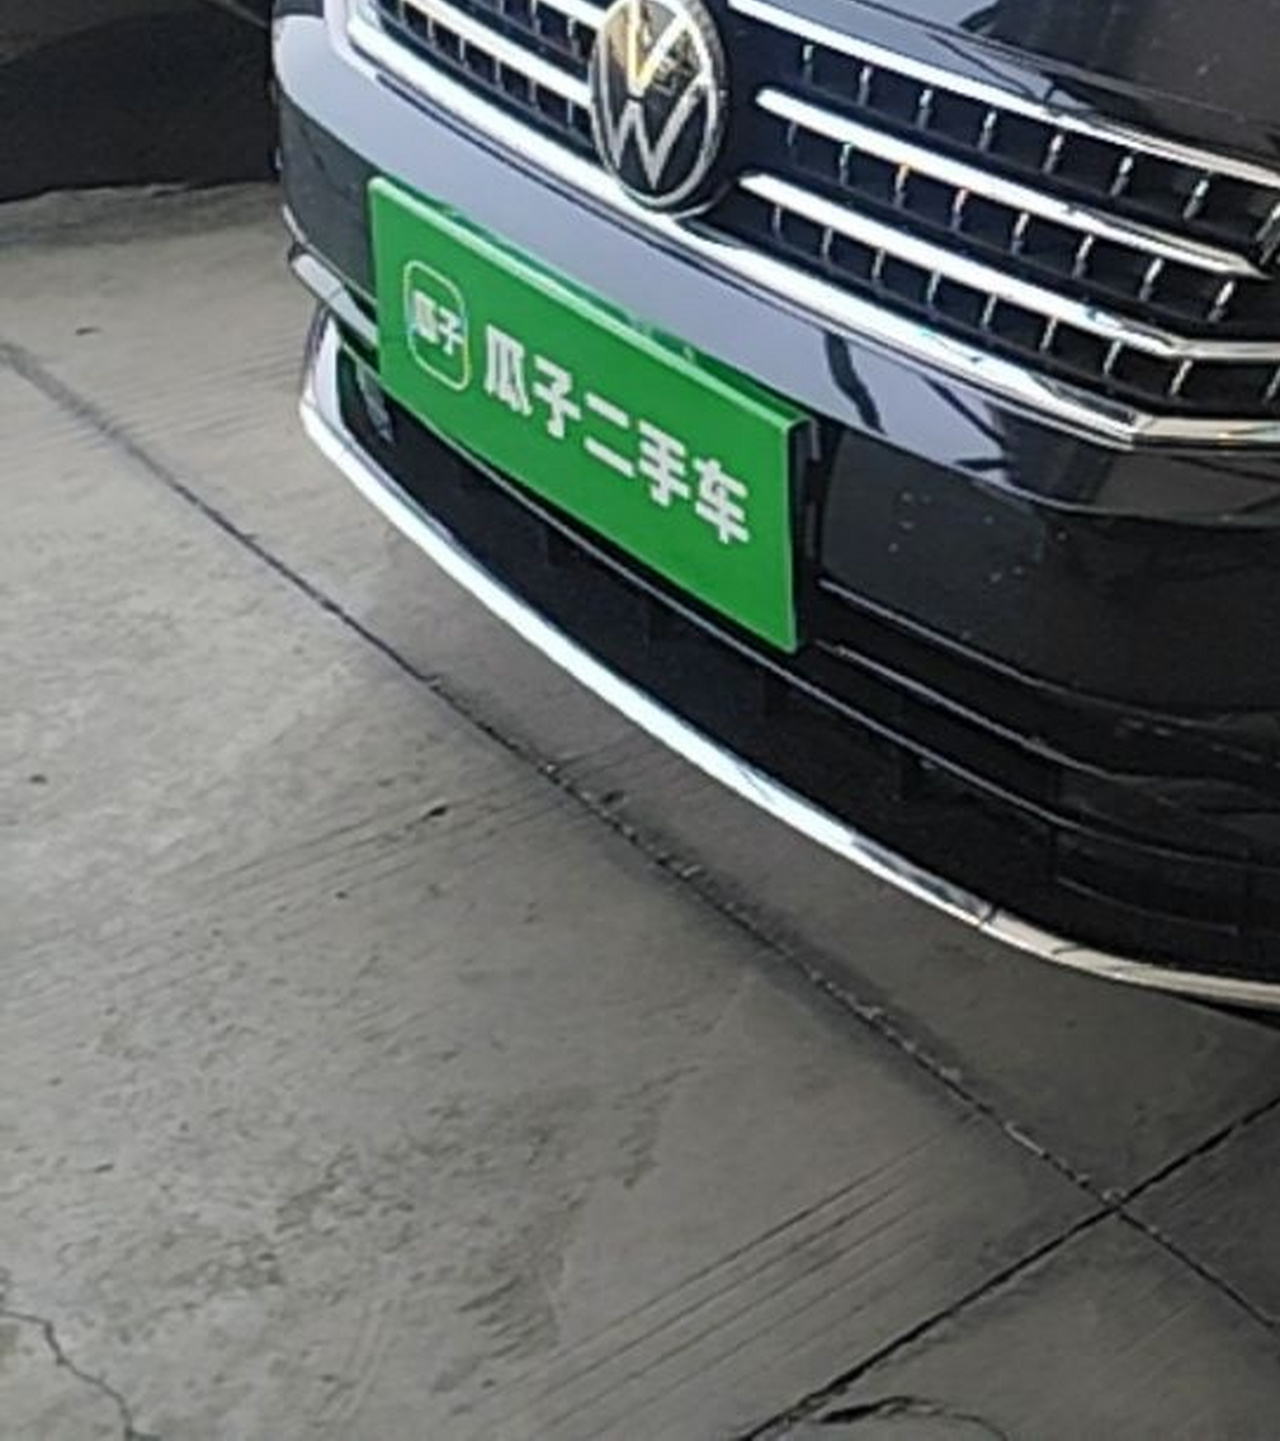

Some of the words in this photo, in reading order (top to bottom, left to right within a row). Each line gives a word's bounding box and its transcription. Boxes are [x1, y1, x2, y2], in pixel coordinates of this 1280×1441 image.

[484, 324, 750, 545] 瓜子二手车
